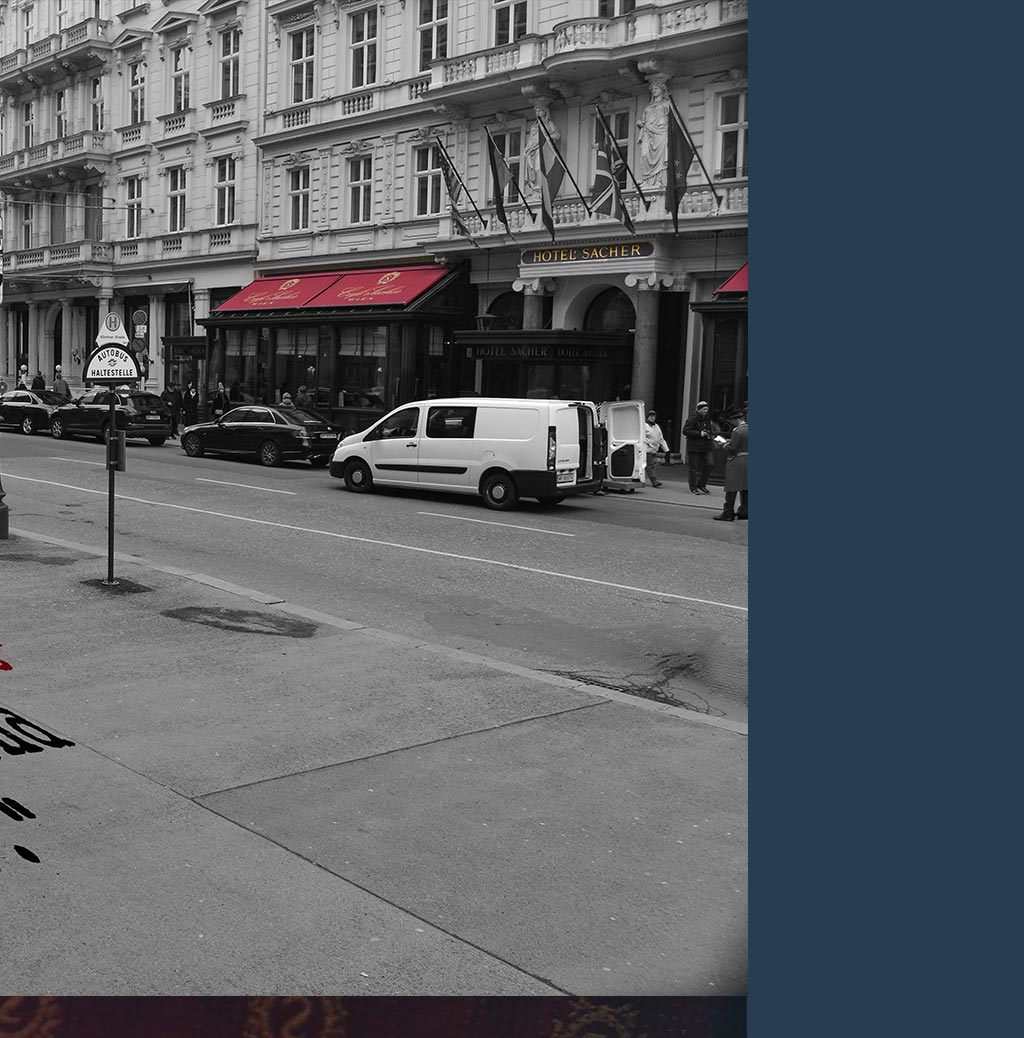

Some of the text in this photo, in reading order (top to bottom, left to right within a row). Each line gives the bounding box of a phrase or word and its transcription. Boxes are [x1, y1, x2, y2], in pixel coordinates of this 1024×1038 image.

[533, 244, 641, 263] HOTEL SACHER
[97, 349, 129, 362] AUTOBUS
